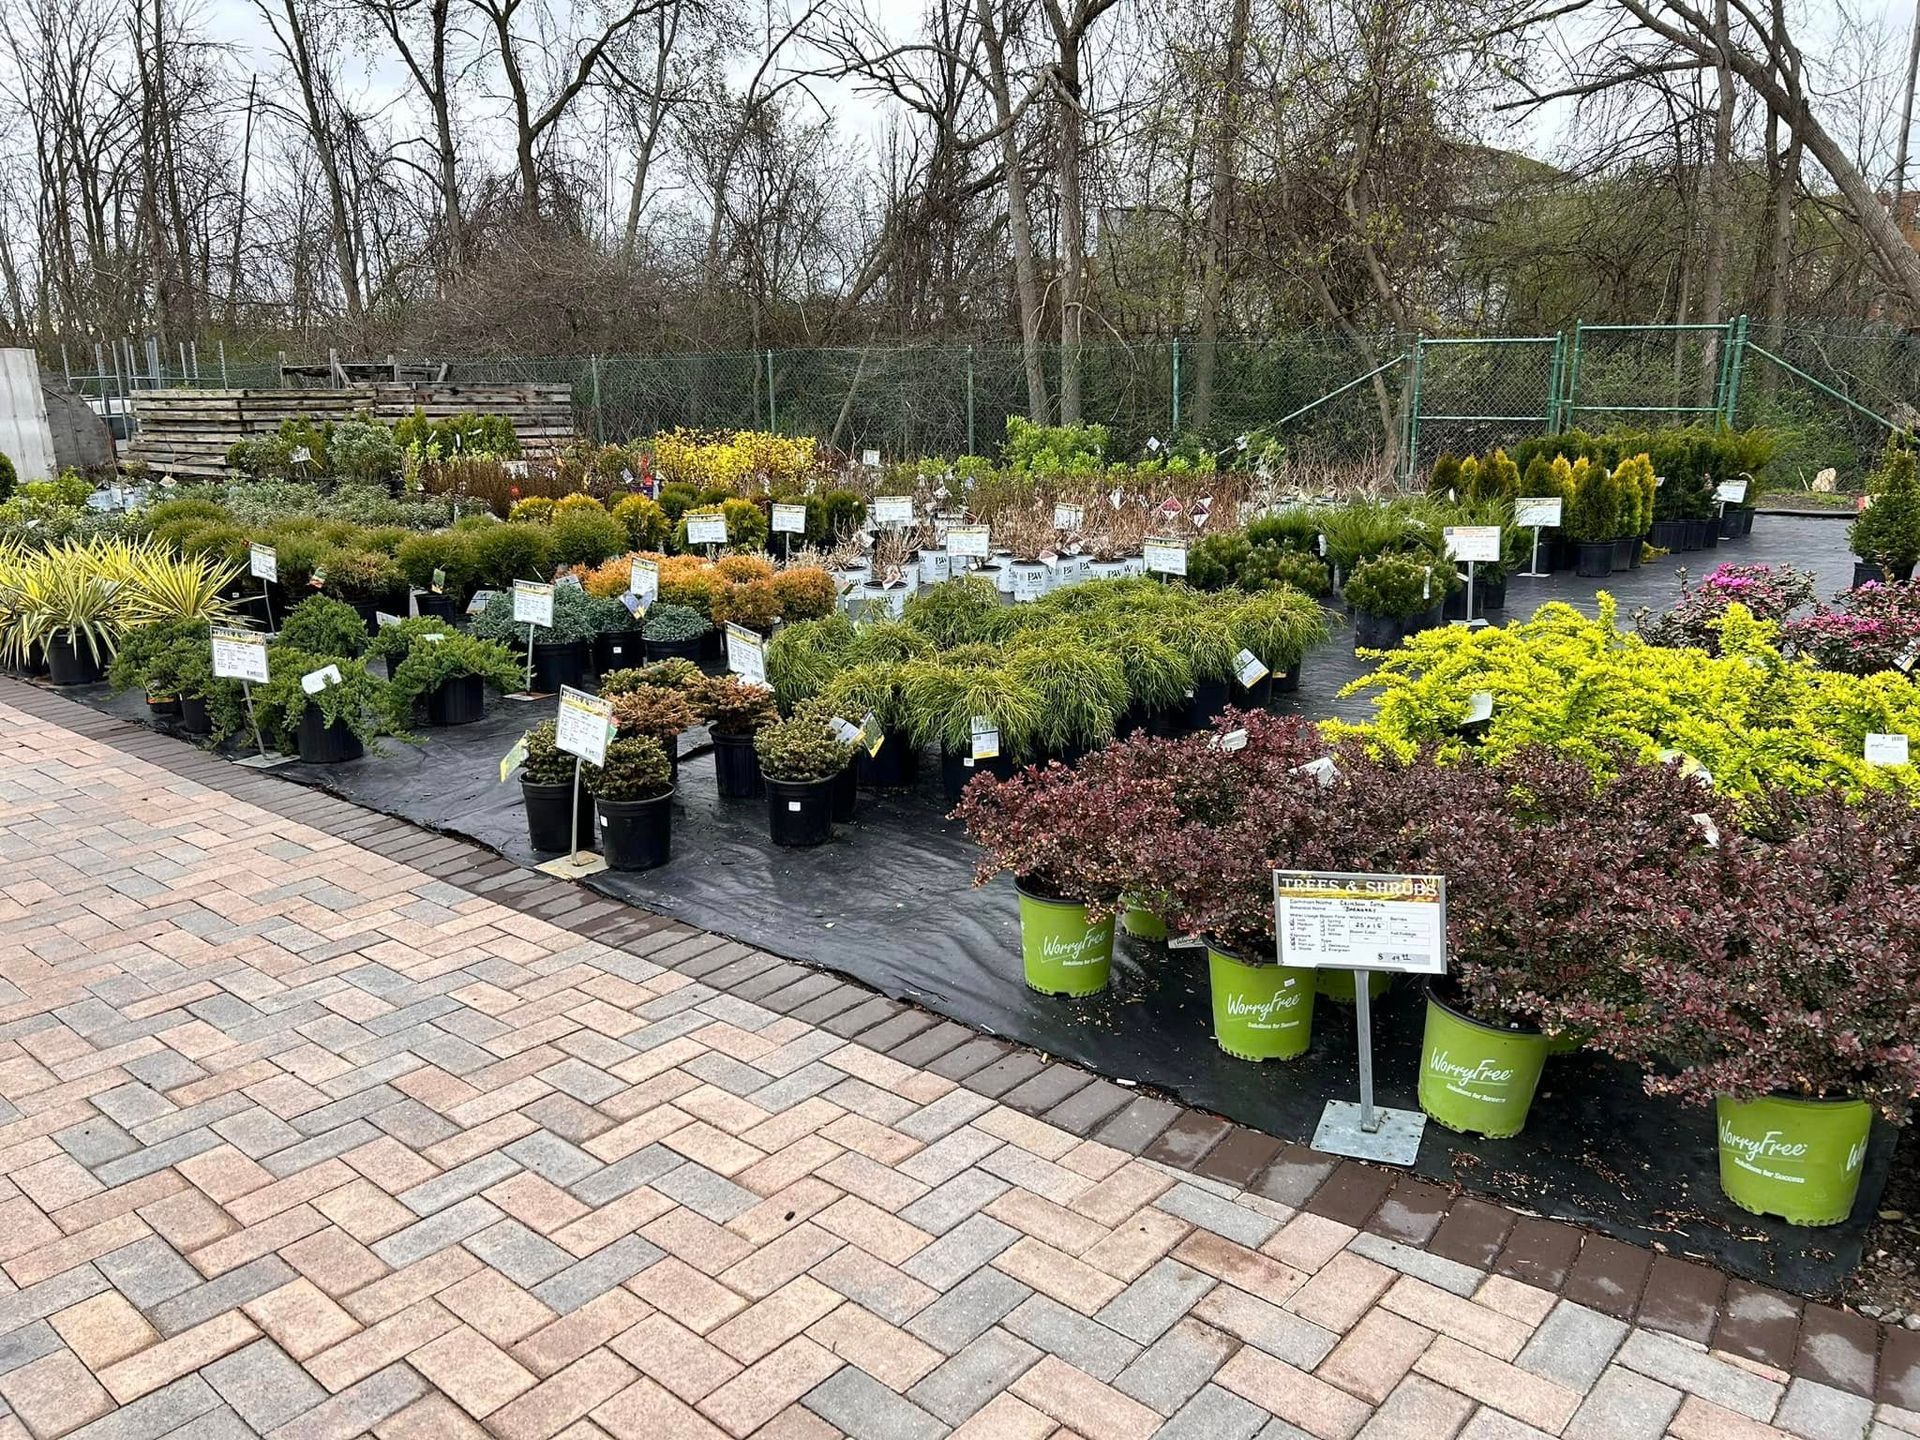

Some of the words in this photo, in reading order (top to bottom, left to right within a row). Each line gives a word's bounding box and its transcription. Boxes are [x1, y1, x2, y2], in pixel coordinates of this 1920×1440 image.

[1281, 878, 1340, 890] TREES
[1346, 880, 1358, 891] &
[1366, 881, 1438, 897] SHRUBS
[1043, 927, 1105, 959] WorryFree
[1227, 989, 1300, 1022] WorryFree
[1430, 1047, 1510, 1086] WorryFree
[1719, 1116, 1806, 1161] WorryFree
[1762, 1169, 1774, 1178] for
